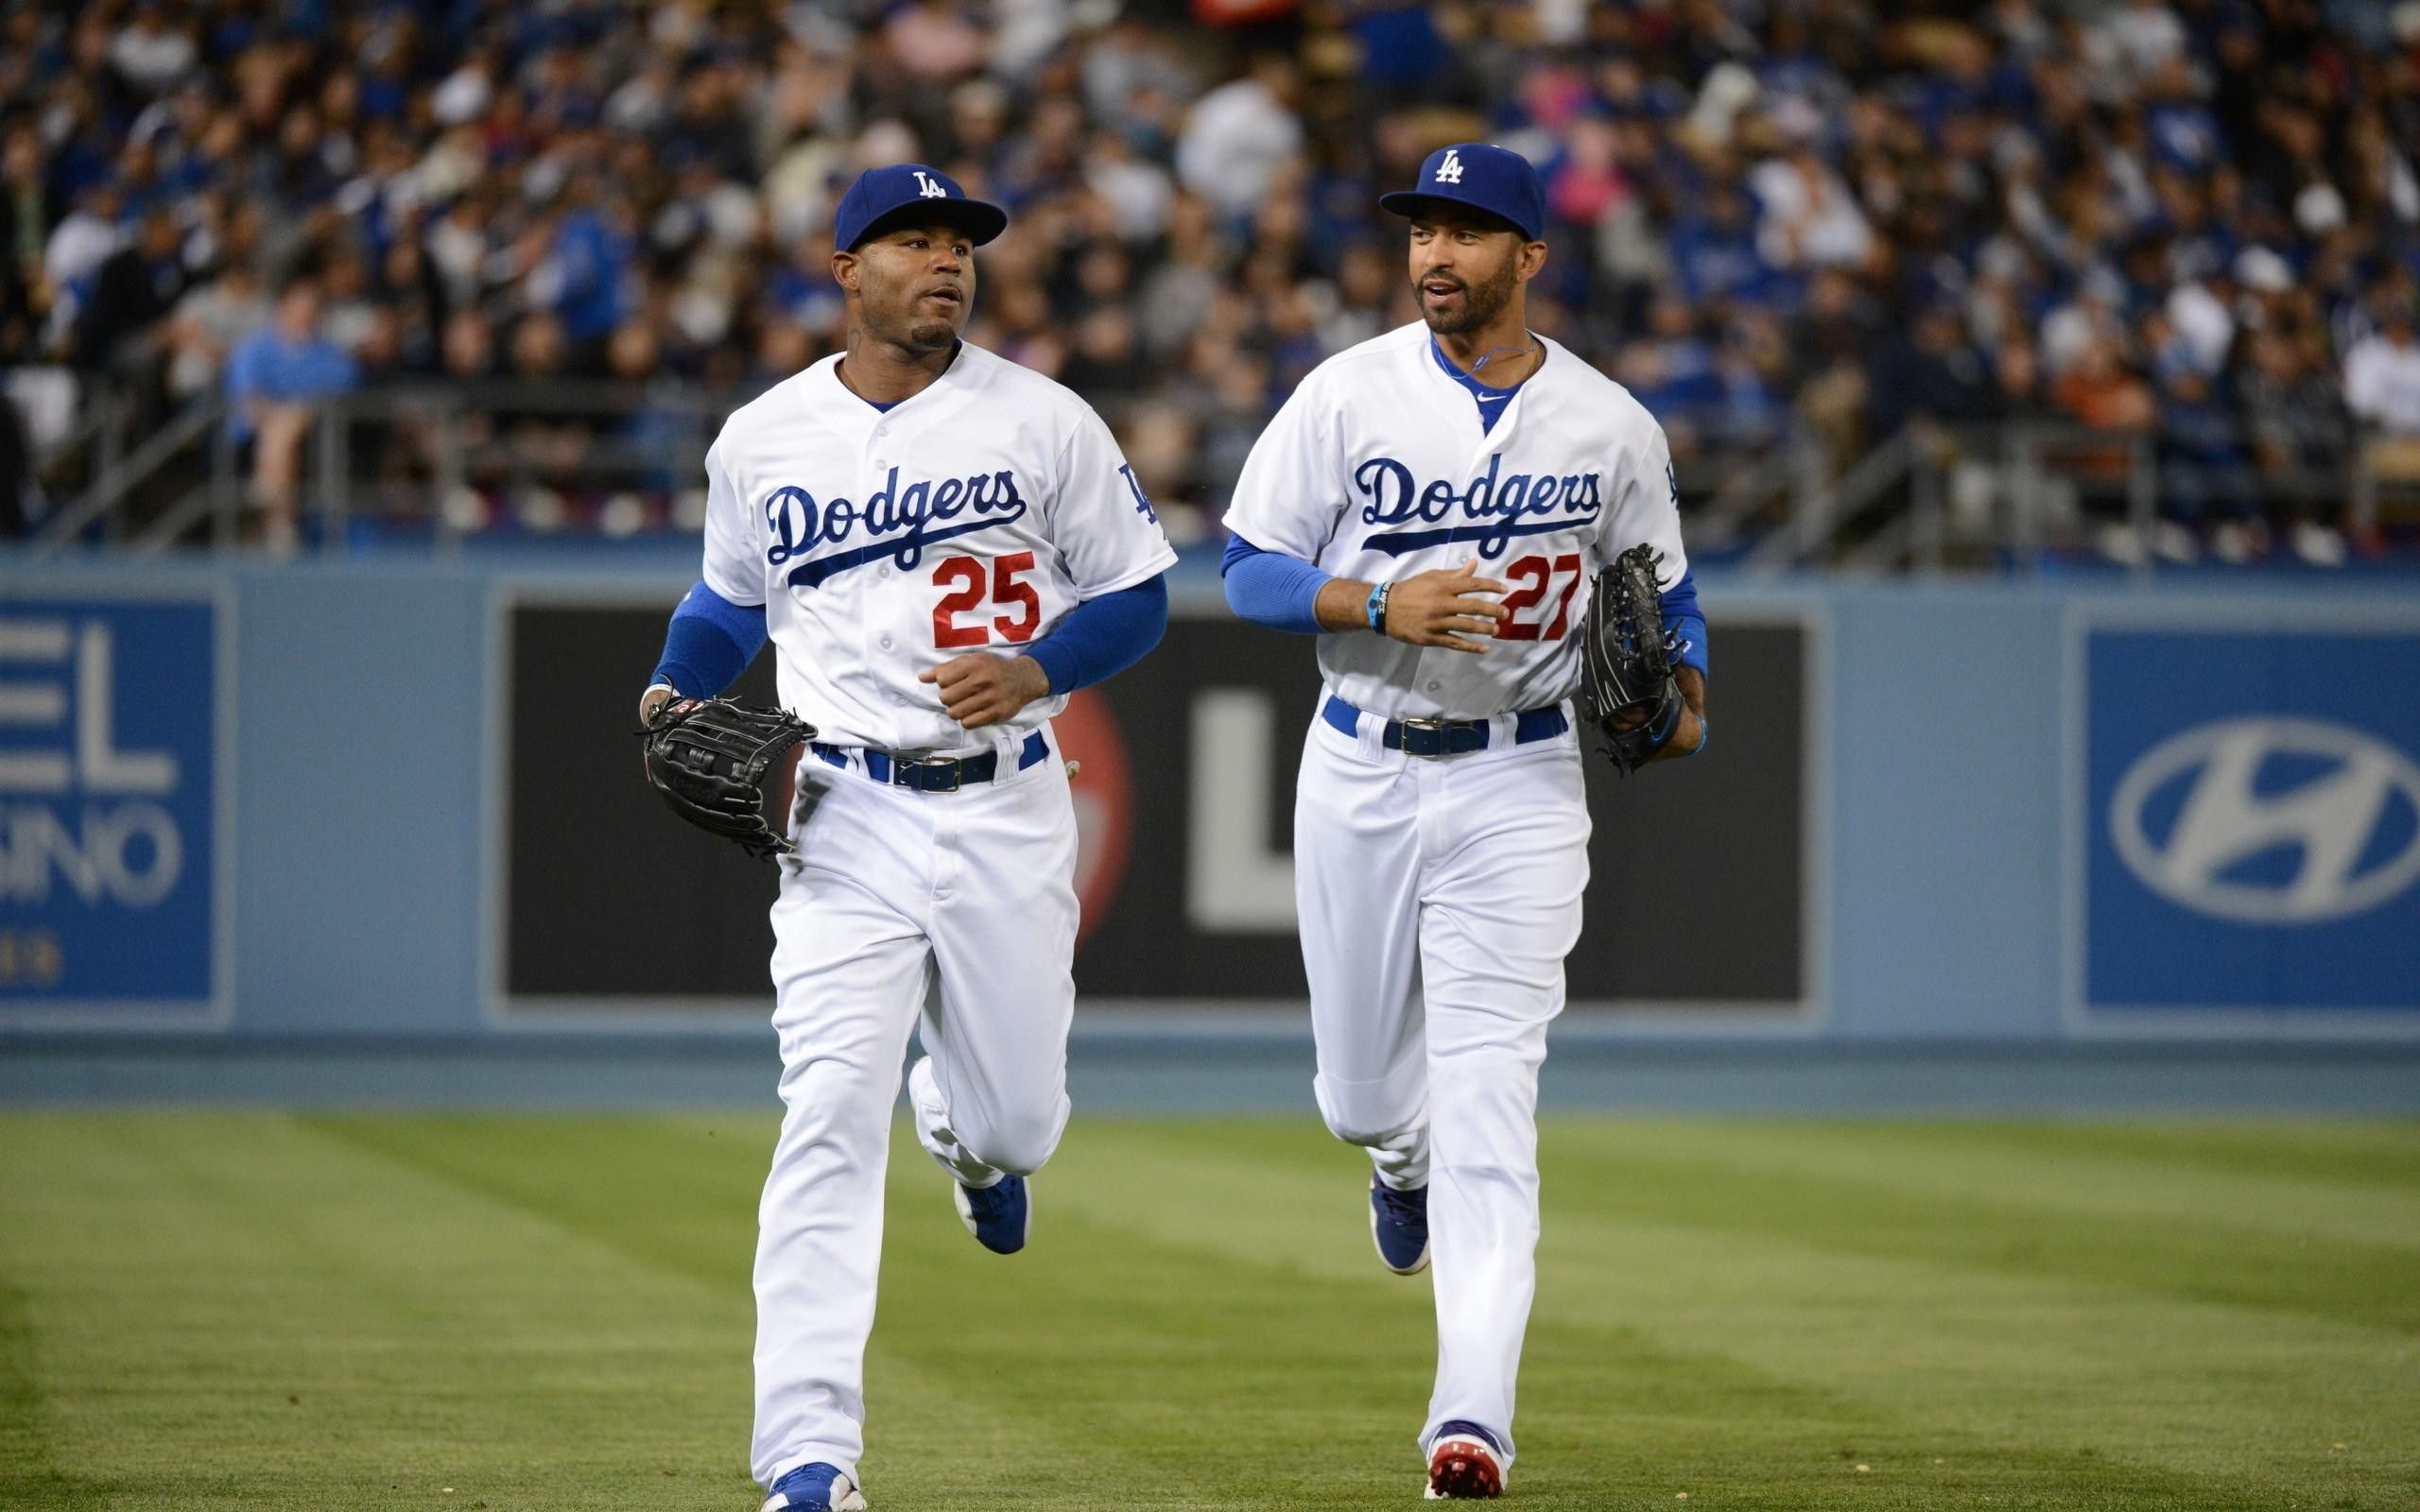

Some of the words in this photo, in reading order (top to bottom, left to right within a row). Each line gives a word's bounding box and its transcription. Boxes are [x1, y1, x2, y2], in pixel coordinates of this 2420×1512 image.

[913, 171, 946, 198] LA
[1435, 149, 1463, 184] LA
[766, 466, 1027, 572] Dodgers
[1355, 453, 1601, 559] Dodgers
[932, 551, 1041, 648] 25
[1492, 553, 1581, 641] 27
